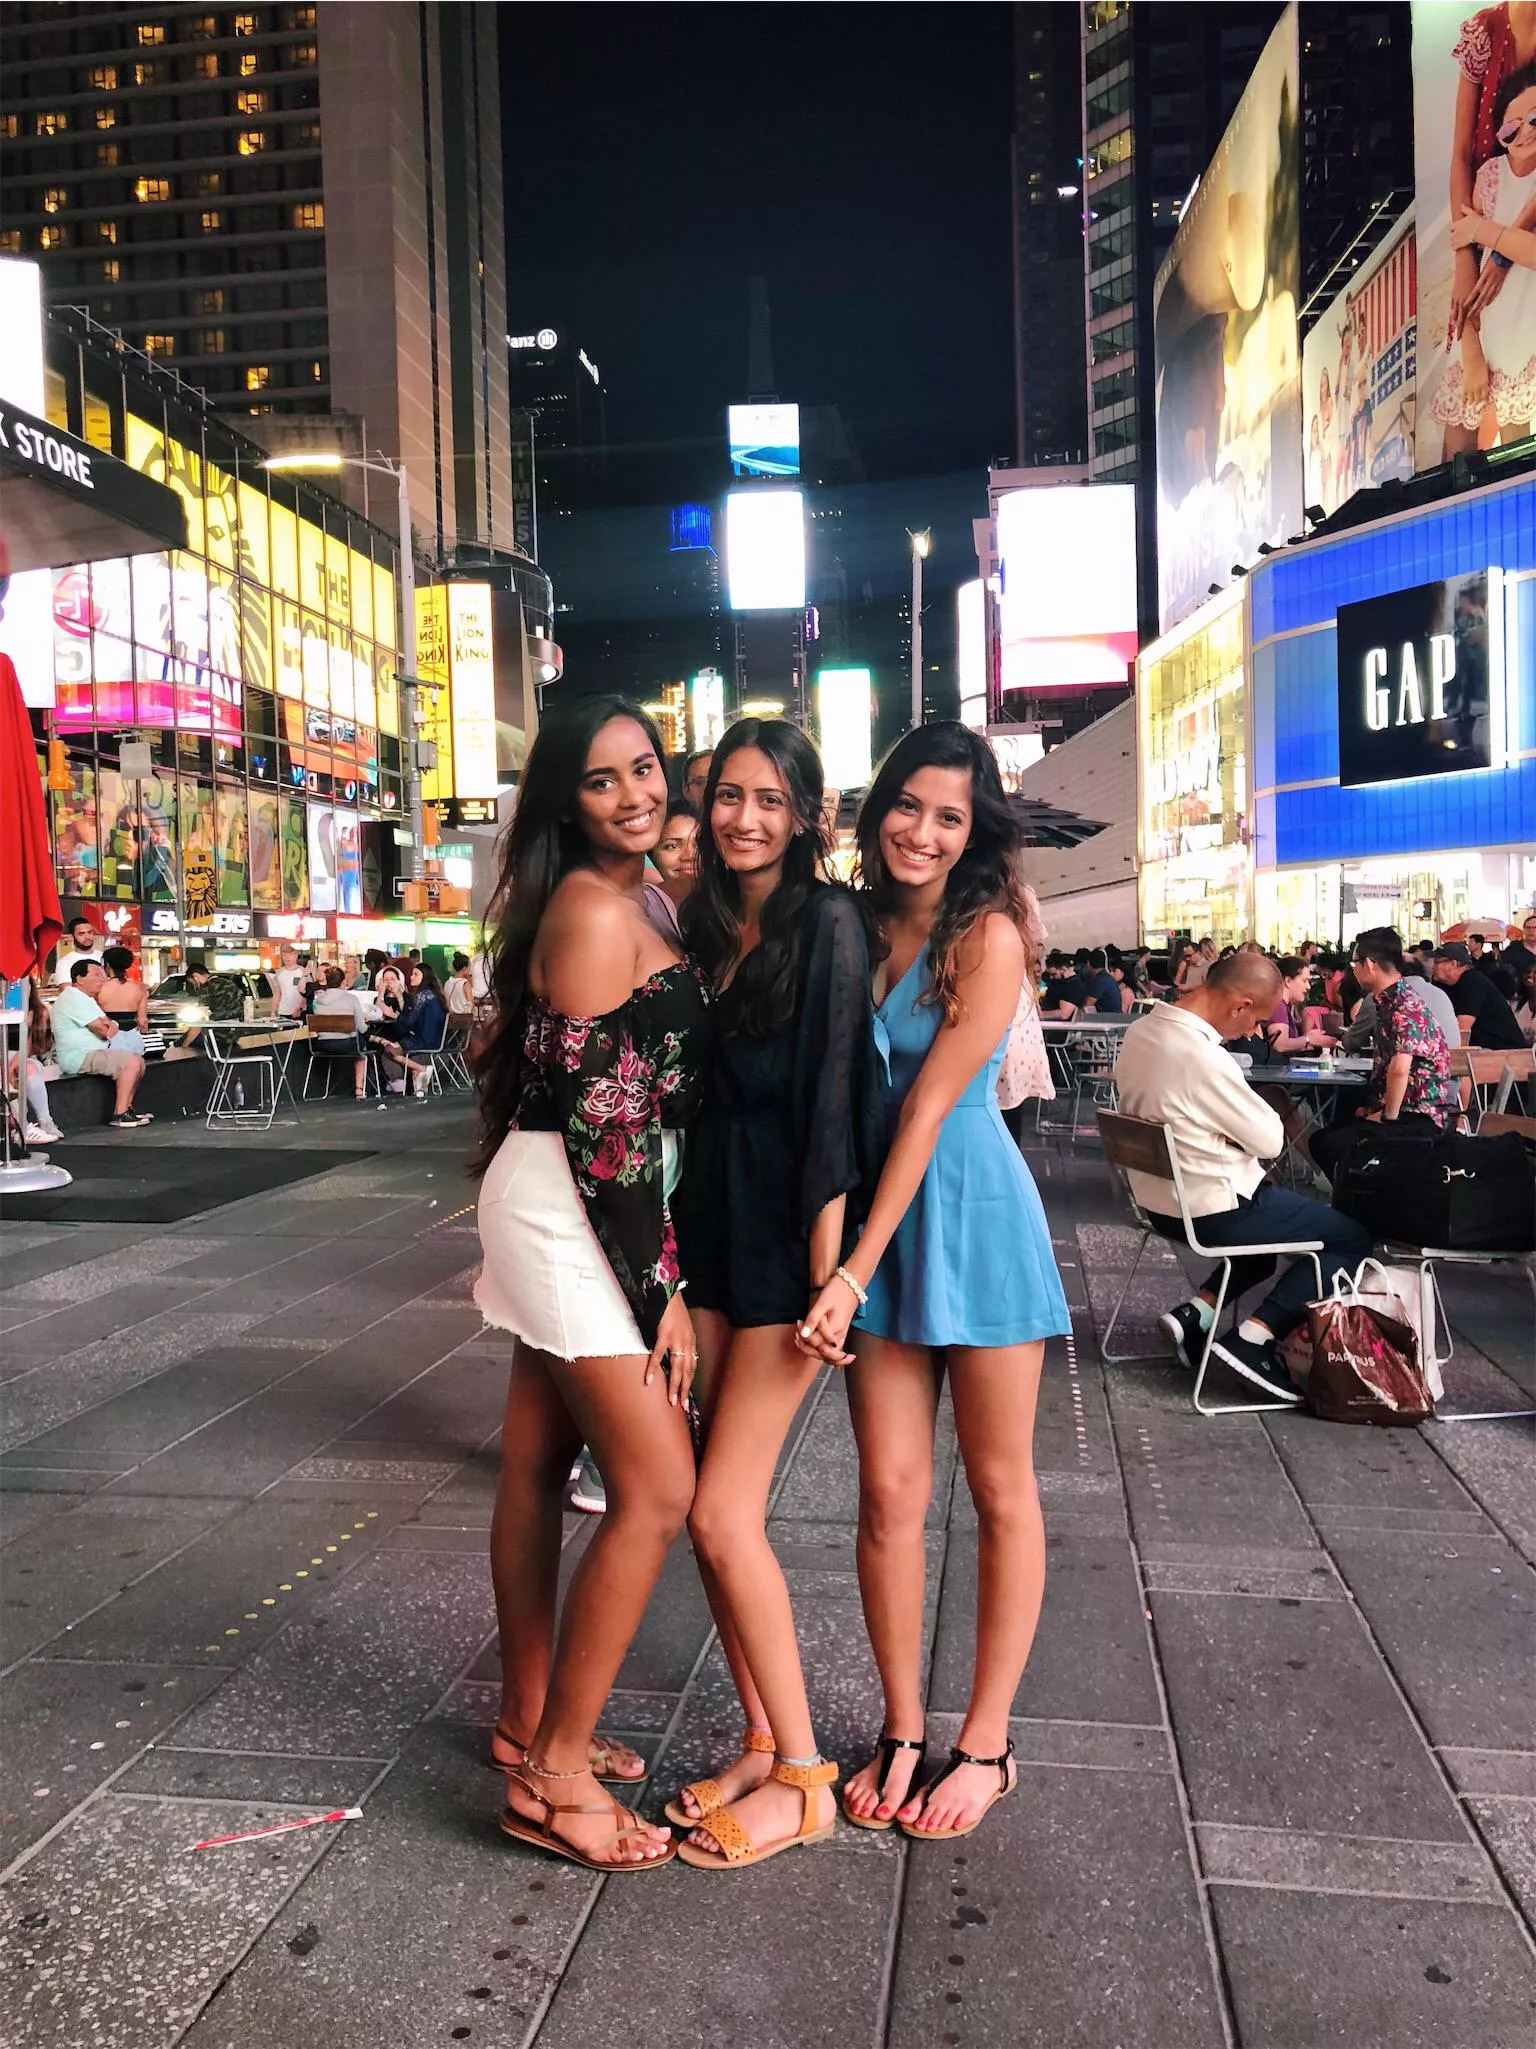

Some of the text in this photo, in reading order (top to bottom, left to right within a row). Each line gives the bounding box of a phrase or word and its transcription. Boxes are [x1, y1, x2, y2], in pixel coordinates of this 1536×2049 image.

[15, 422, 95, 489] STORE
[511, 442, 530, 541] TIMES
[315, 561, 349, 608] THE
[455, 644, 489, 663] KING
[456, 626, 484, 642] LION
[1365, 633, 1456, 731] GAP
[151, 910, 251, 934] SKERS
